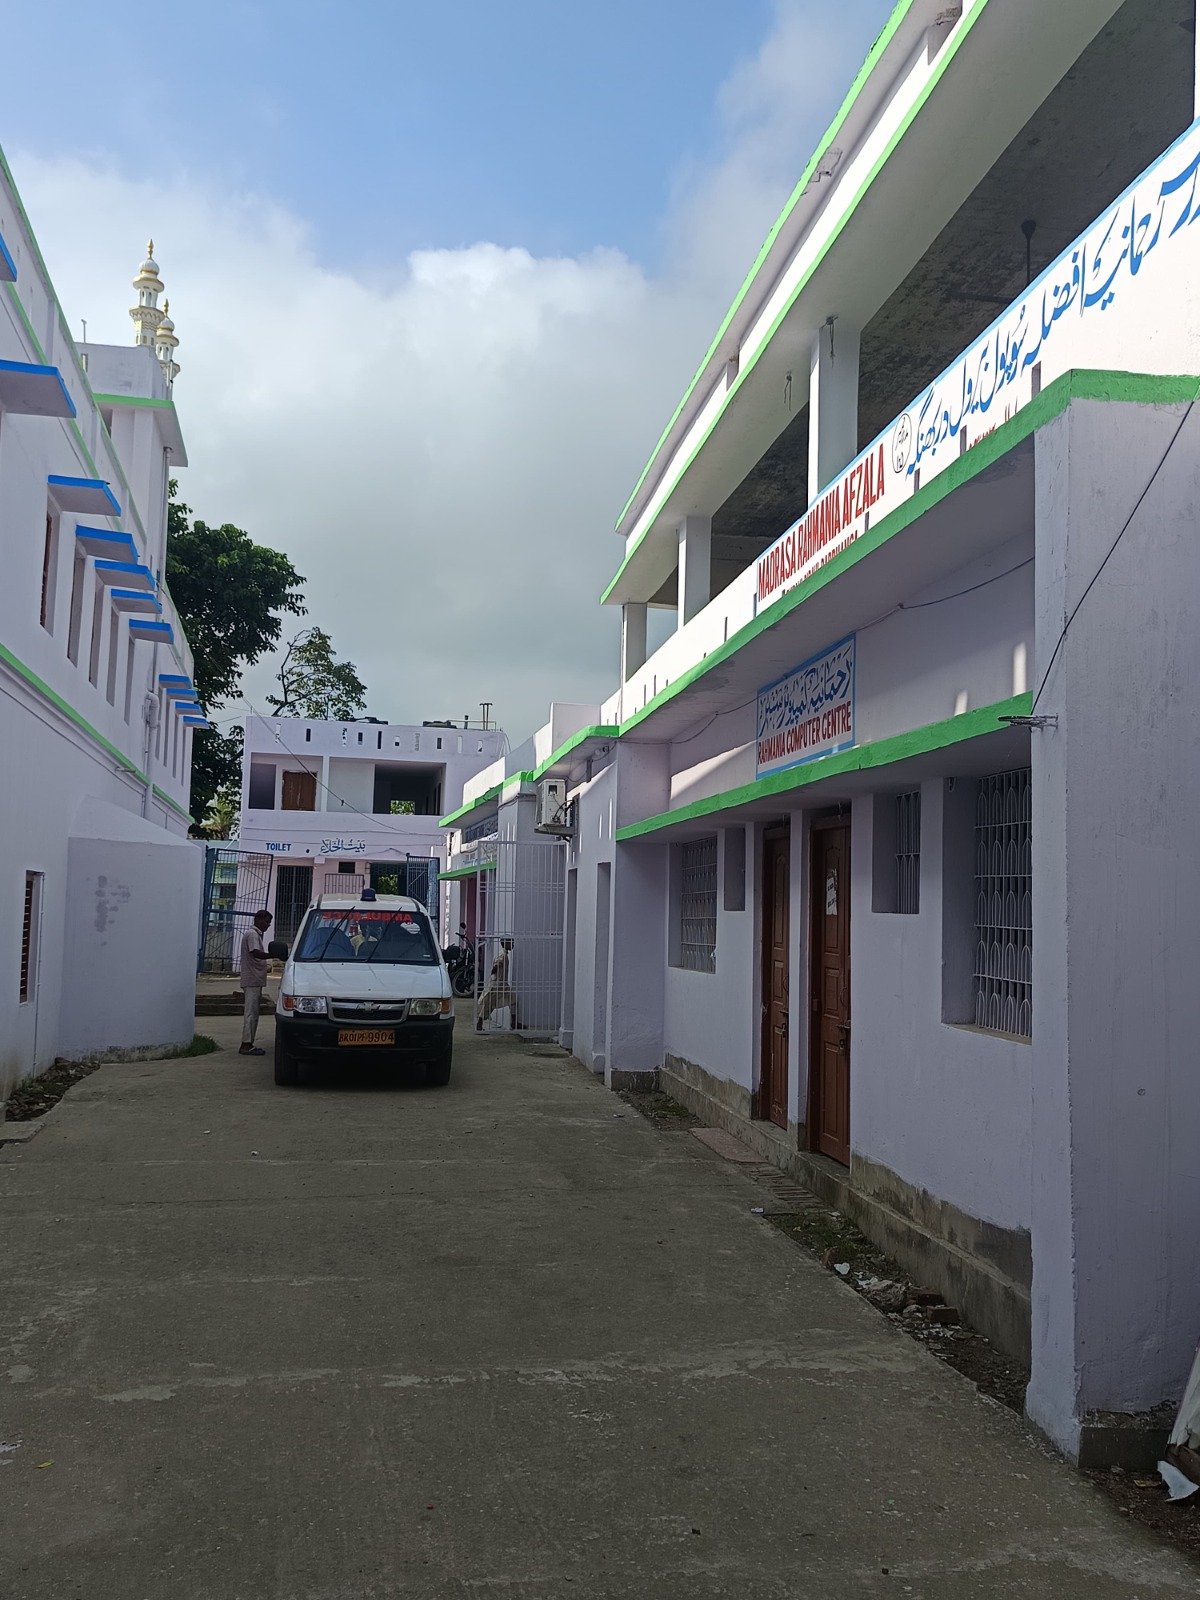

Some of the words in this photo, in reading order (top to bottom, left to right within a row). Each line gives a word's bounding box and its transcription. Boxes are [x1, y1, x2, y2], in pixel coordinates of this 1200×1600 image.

[758, 531, 796, 603] MADRASA
[798, 503, 840, 570] RAHMANIA
[842, 443, 884, 530] AFZALA
[787, 715, 821, 754] COMPUTER
[822, 701, 851, 741] CENTRE
[265, 842, 292, 851] TOILET
